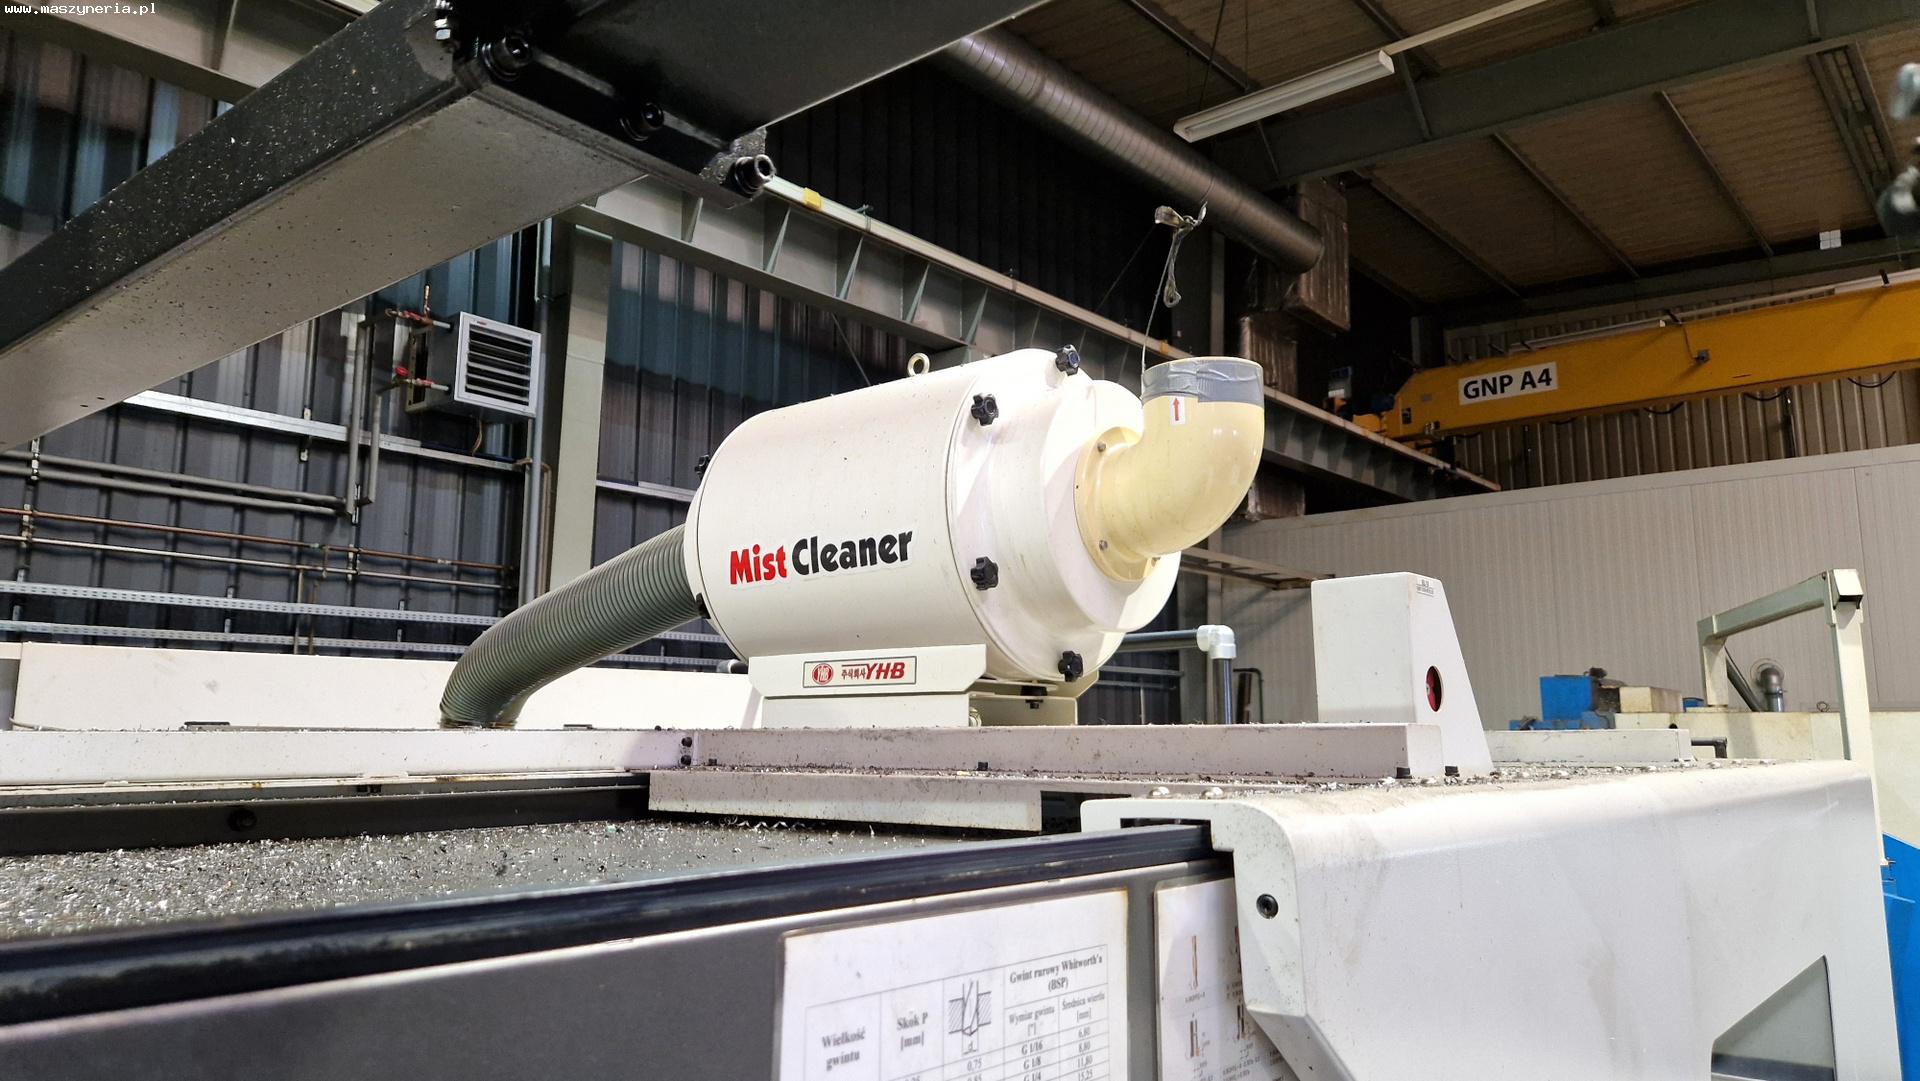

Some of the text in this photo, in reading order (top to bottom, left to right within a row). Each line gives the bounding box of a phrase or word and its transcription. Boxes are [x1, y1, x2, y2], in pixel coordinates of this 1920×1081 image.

[1463, 367, 1552, 399] GNP A4
[730, 530, 912, 585] Mist Cleaner
[864, 662, 906, 680] YHB
[1009, 969, 1033, 984] Gwint
[1047, 977, 1069, 993] (BSP)
[896, 1012, 928, 1031] Skok P
[821, 1026, 866, 1048] Wielkość
[1021, 1044, 1028, 1055] G
[826, 1051, 860, 1071] gwintu
[1023, 1060, 1030, 1070] G
